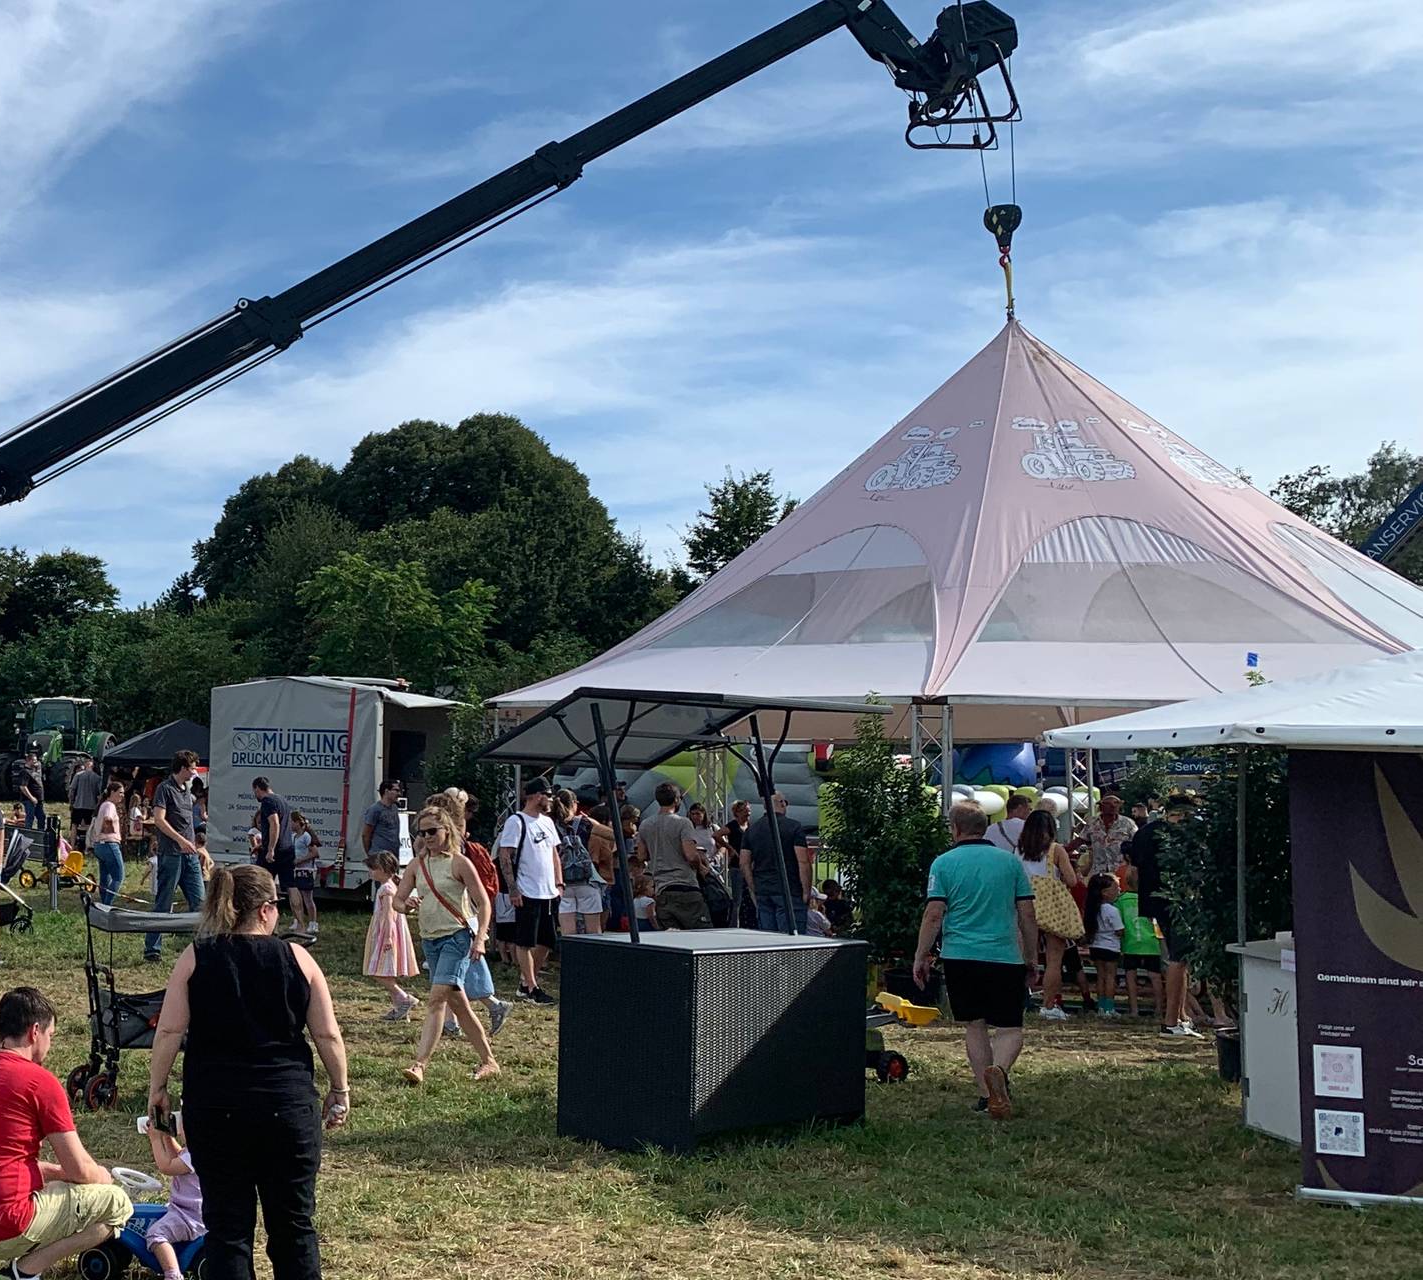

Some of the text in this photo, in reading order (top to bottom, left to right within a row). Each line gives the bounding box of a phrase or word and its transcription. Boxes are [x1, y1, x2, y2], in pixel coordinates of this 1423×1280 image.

[262, 729, 349, 754] MÜHLING
[232, 752, 347, 768] DRUCKLUFTSYSTEME
[300, 806, 350, 816] Druckluftsystee
[1317, 973, 1377, 985] Gemeinsam
[1378, 977, 1400, 986] sind
[1400, 979, 1418, 988] wir
